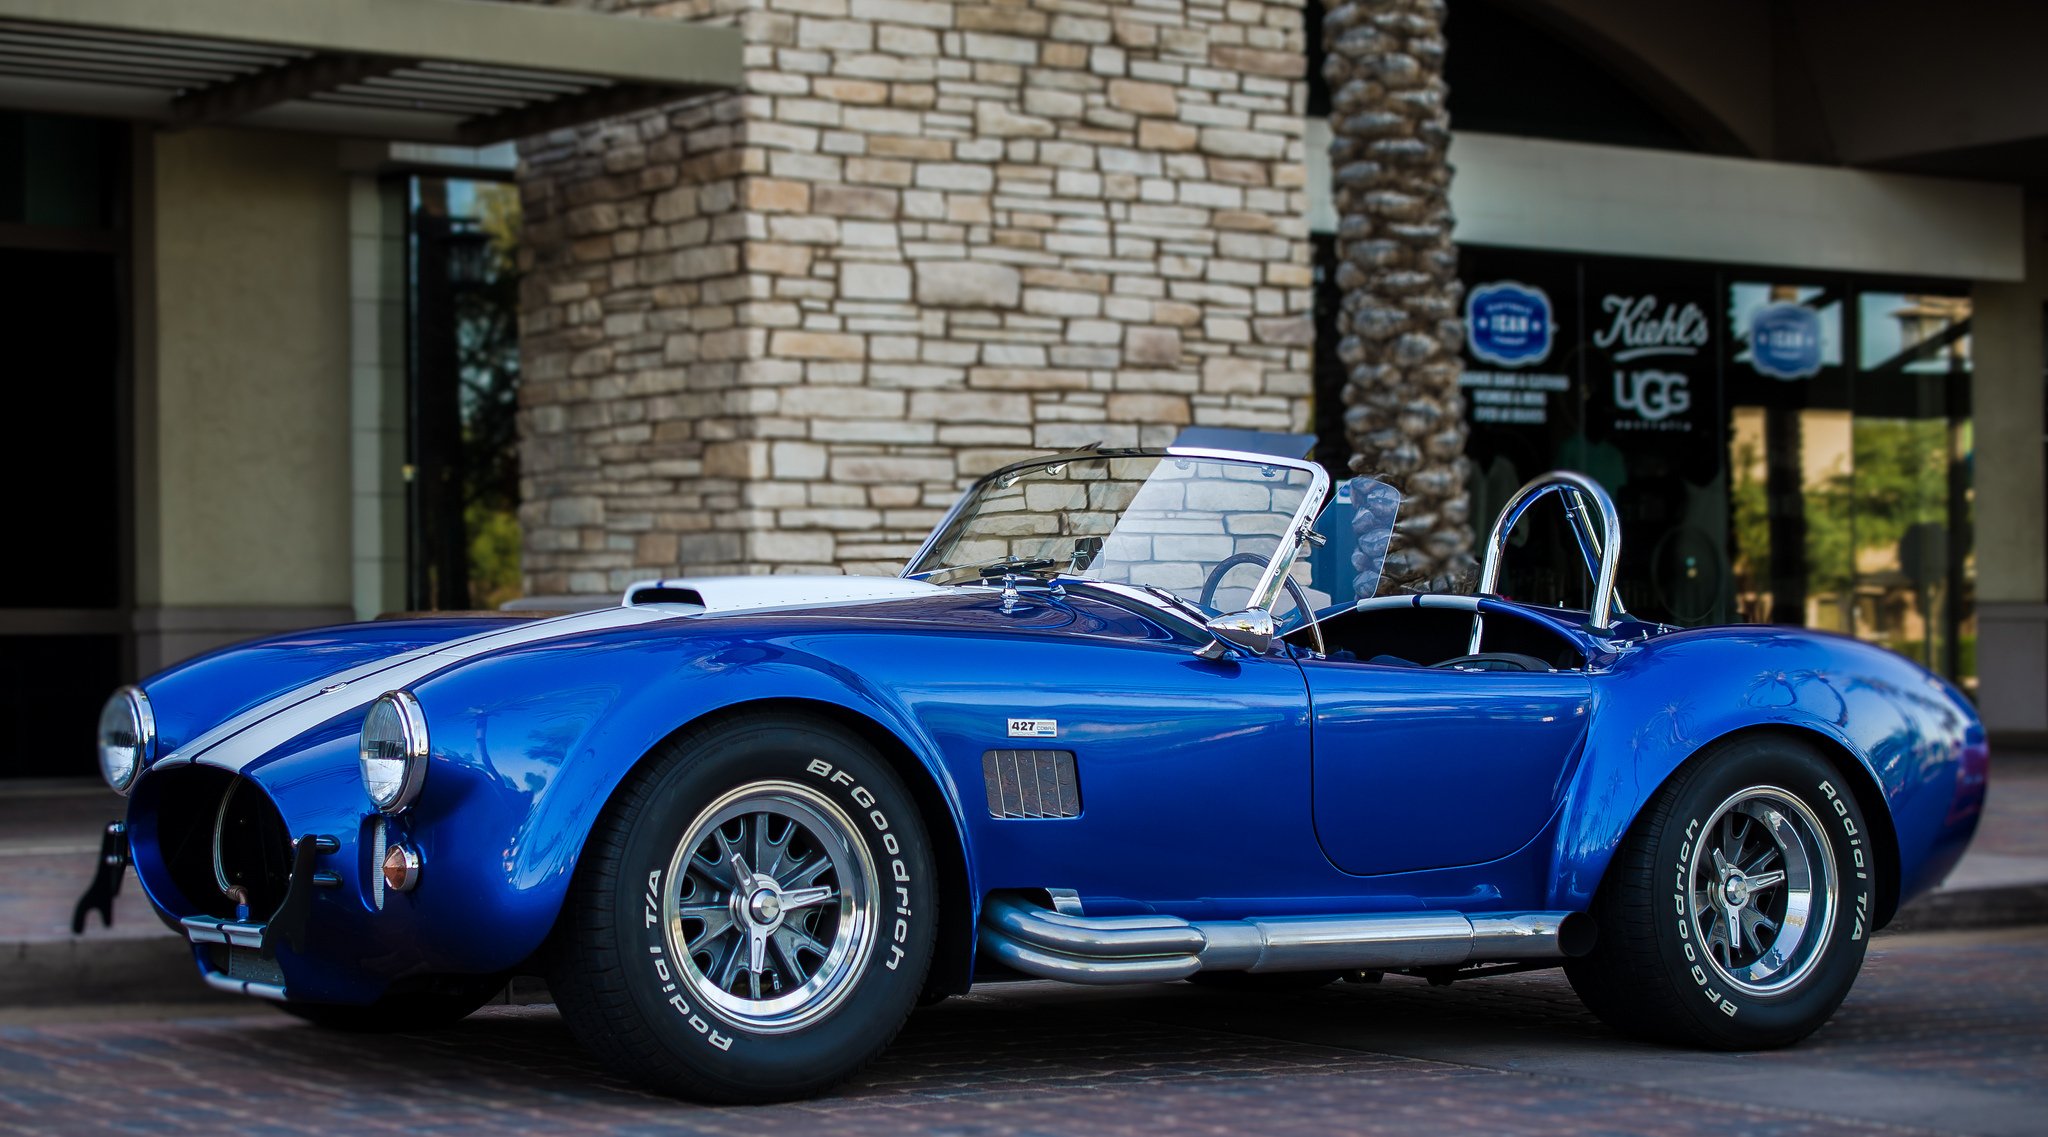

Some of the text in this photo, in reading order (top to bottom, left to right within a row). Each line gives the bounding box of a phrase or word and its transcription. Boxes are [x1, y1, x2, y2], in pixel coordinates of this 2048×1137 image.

[1593, 294, 1708, 348] Kiehl's
[1614, 369, 1690, 420] UGG
[1011, 721, 1036, 731] 427
[806, 758, 911, 970] BFGoodrich
[1674, 818, 1738, 1018] BFGoodrich
[1818, 780, 1867, 940] Radial T/A
[646, 870, 733, 1051] Radial T/A
